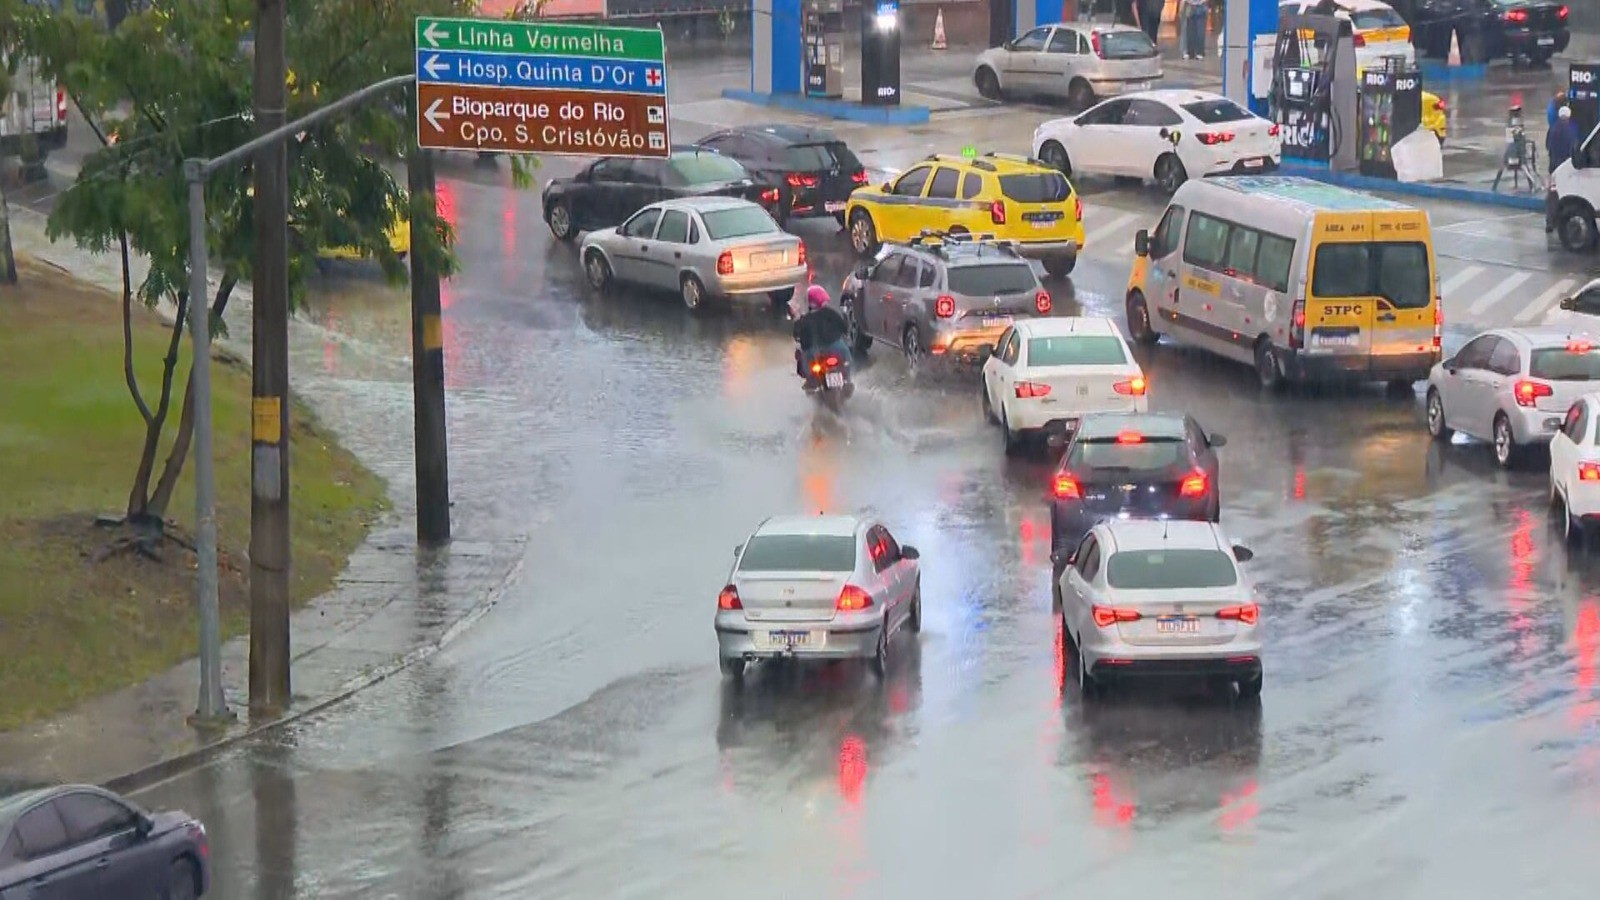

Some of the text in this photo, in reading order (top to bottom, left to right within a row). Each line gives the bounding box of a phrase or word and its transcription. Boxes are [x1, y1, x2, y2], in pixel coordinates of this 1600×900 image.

[458, 27, 625, 53] Linha Vermelha
[458, 58, 635, 86] Hosp. Quinta D'Or
[453, 96, 625, 122] Bioparque do Rio
[460, 121, 645, 149] Cpo. S. Cristóvão
[1324, 305, 1362, 315] STPC
